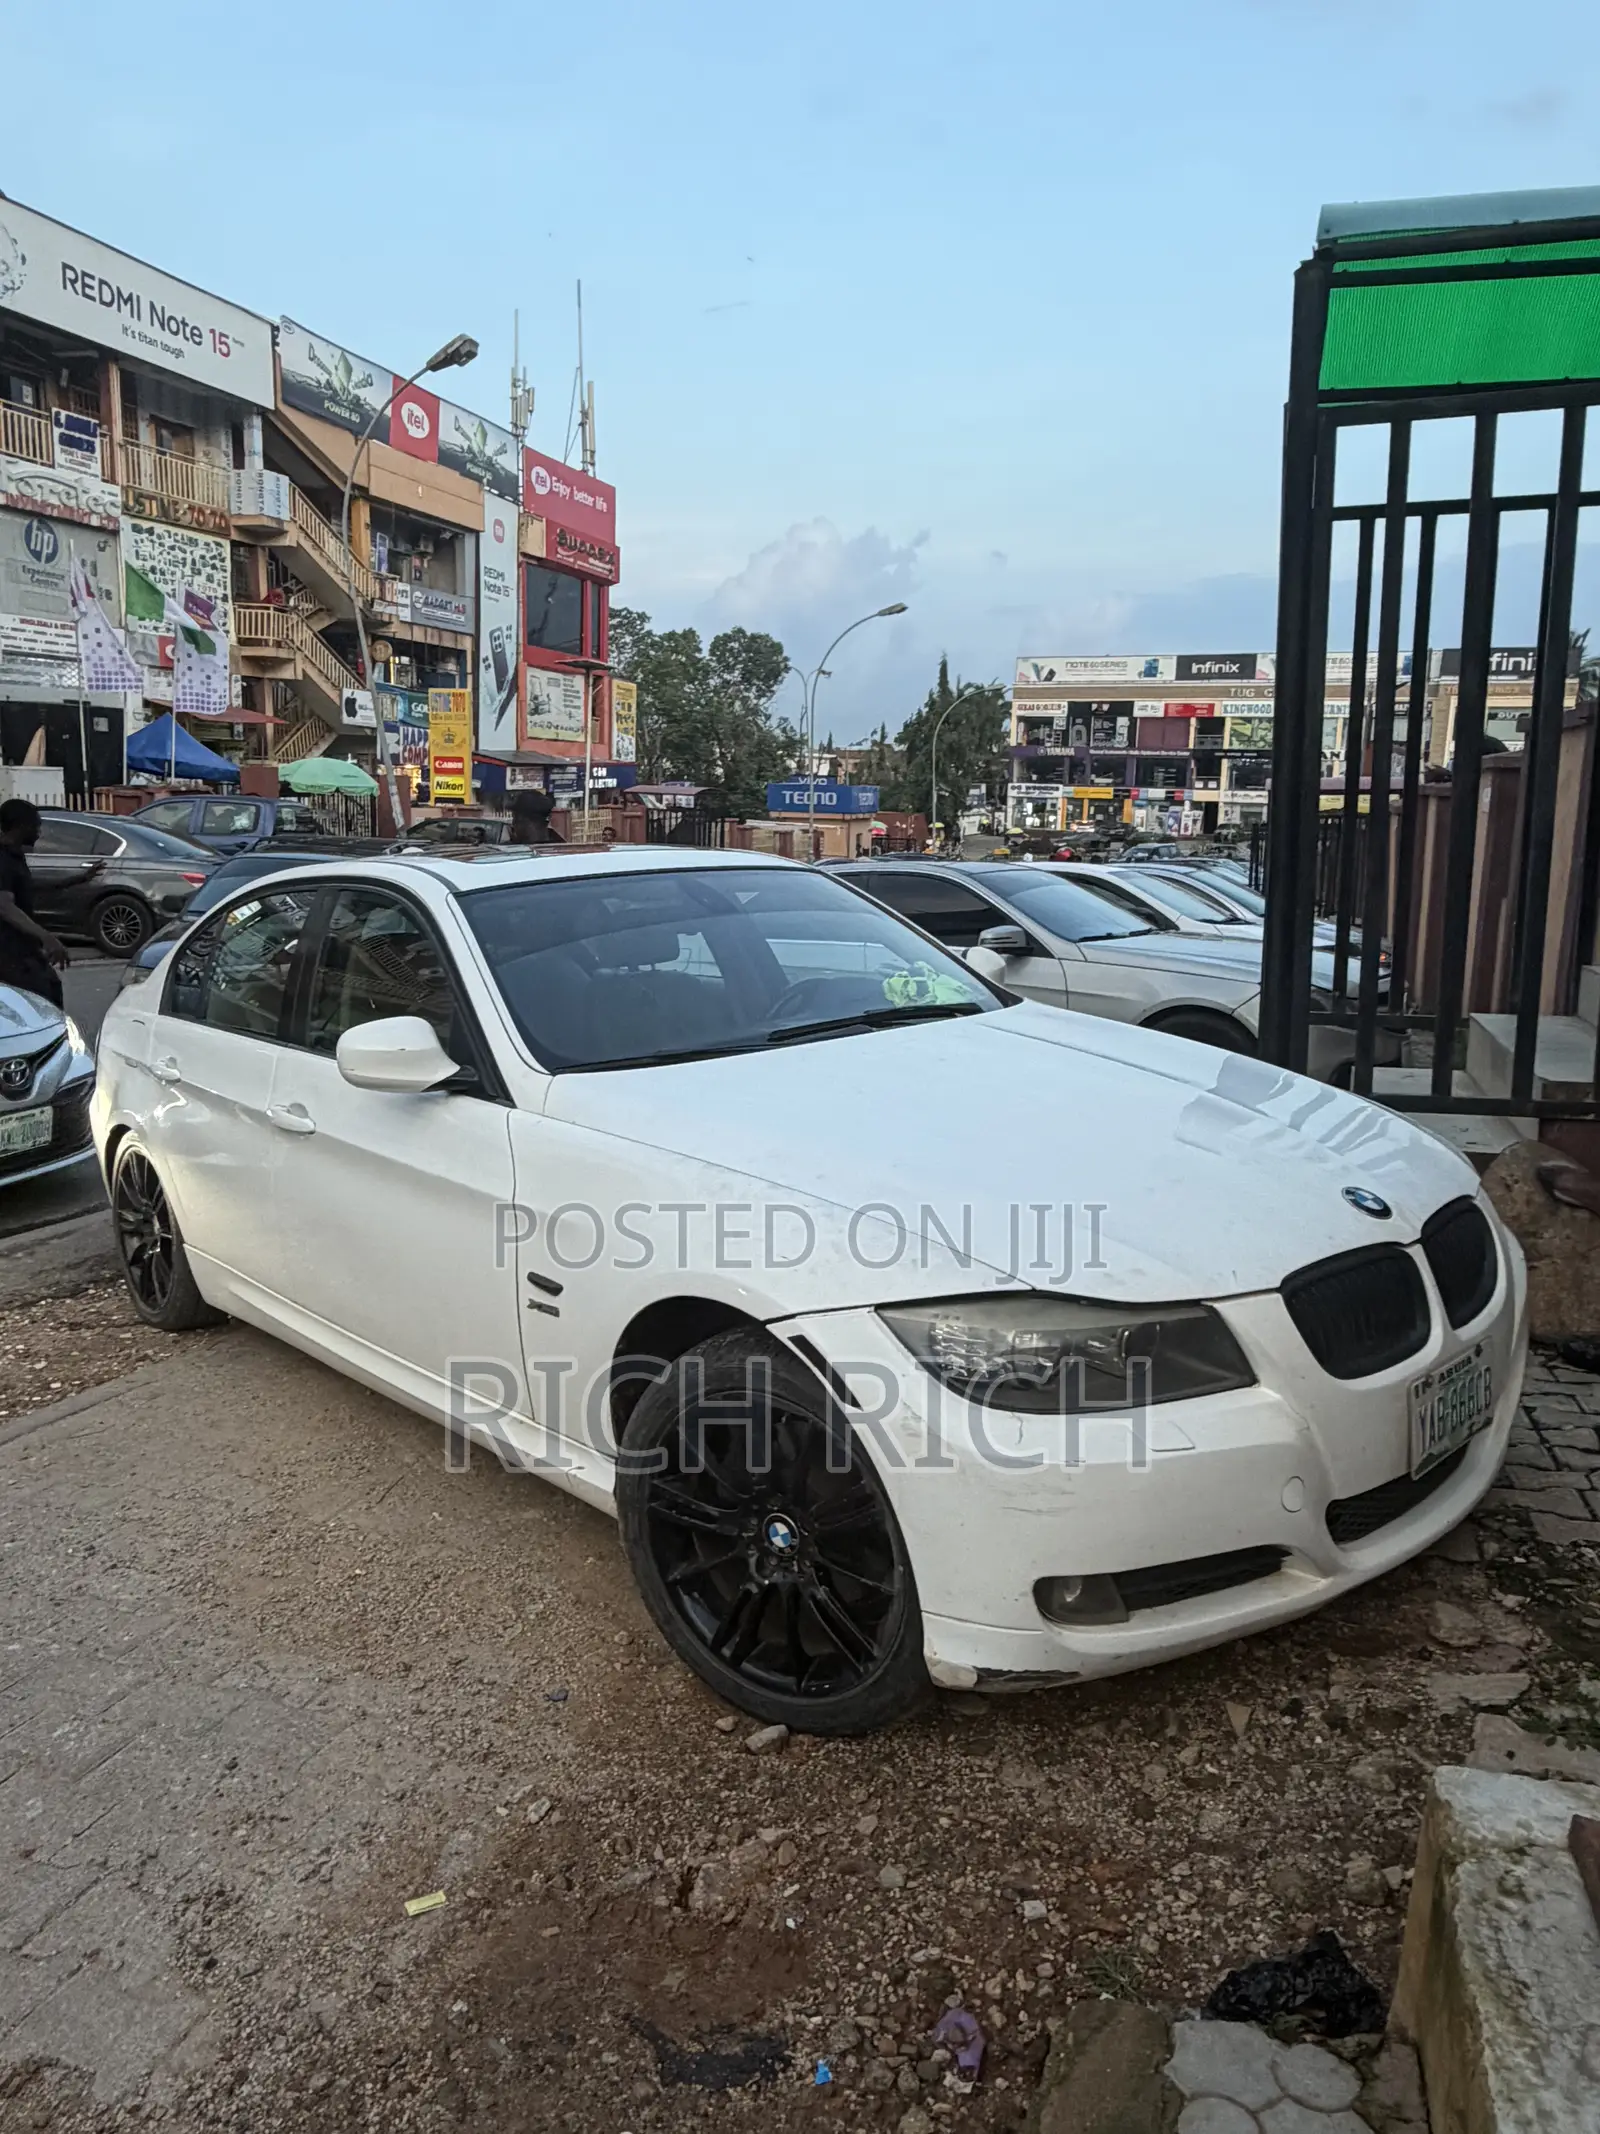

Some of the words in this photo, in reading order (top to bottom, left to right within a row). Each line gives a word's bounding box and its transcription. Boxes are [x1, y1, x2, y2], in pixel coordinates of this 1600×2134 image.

[61, 261, 142, 322] REDMI
[149, 300, 203, 347] Note
[209, 328, 231, 358] 15
[121, 323, 137, 340] It's
[137, 331, 159, 348] titan
[160, 337, 185, 359] tough
[323, 400, 350, 420] POWER
[406, 408, 425, 433] itel
[551, 475, 571, 500] Enjoy
[573, 485, 595, 508] better
[595, 496, 608, 513] life
[30, 519, 54, 564] hp
[483, 579, 502, 596] Note
[1191, 660, 1240, 674] Infinix
[1489, 652, 1536, 671] fini
[1222, 703, 1272, 714] KINGWOOD
[1046, 747, 1075, 756] YAMAHA
[435, 760, 463, 769] Canon
[435, 781, 463, 791] Nikon
[781, 791, 837, 806] TECNO
